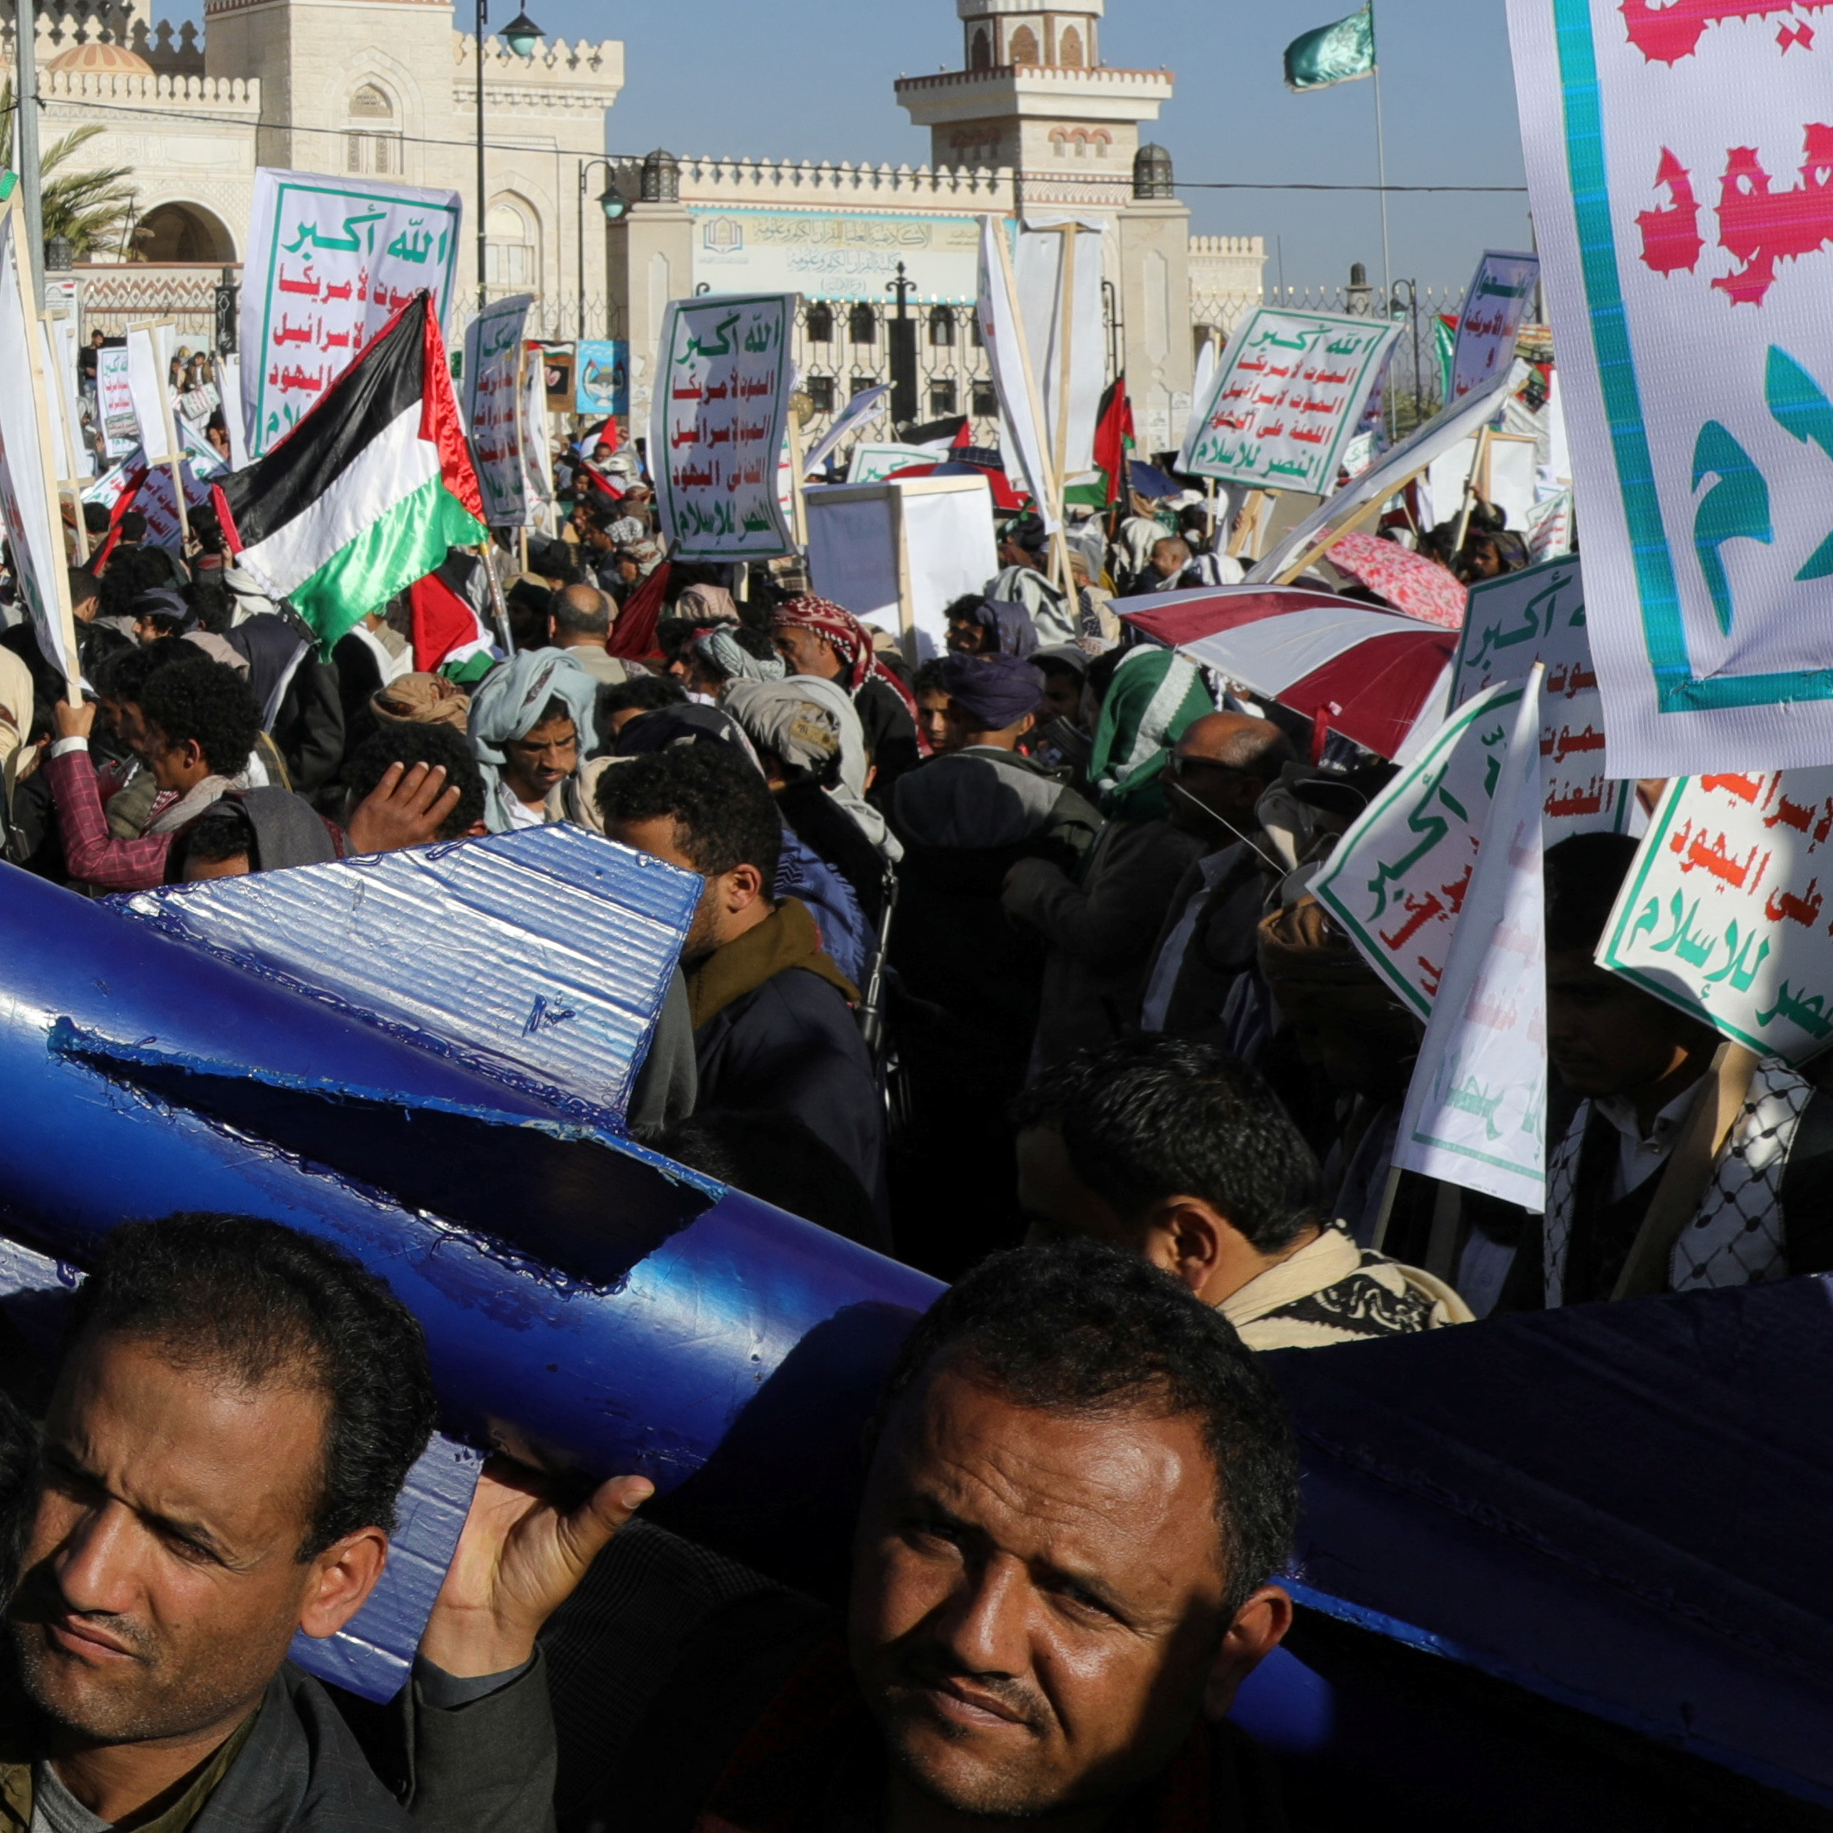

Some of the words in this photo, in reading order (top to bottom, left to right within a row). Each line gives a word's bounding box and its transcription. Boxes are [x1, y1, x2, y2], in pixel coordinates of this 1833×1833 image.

[281, 203, 387, 261] أكبر
[387, 217, 448, 267] الله
[279, 263, 369, 304] لأمريكا
[675, 309, 741, 370] أكبر
[744, 313, 781, 354] الله
[1248, 323, 1333, 353] أكبر
[1325, 331, 1378, 355] الله
[269, 362, 333, 398] اليهود
[671, 365, 740, 406] لأمريكا
[1236, 353, 1304, 379] لأمريكا
[1303, 366, 1358, 385] الموت
[1222, 380, 1288, 411] لإسرائيل
[1289, 395, 1345, 415] الموت
[1256, 417, 1284, 439] على
[1288, 419, 1334, 446] اللعنة
[1196, 436, 1262, 474] للإسلام
[1261, 449, 1324, 479] النصر
[672, 459, 720, 493] اليهود
[1466, 570, 1572, 670] أكبر
[1540, 724, 1605, 764] موت
[1366, 761, 1469, 924] أكبر
[1670, 818, 1772, 896] اليهود
[1764, 877, 1823, 928] على
[1627, 886, 1771, 1000] للإسلام
